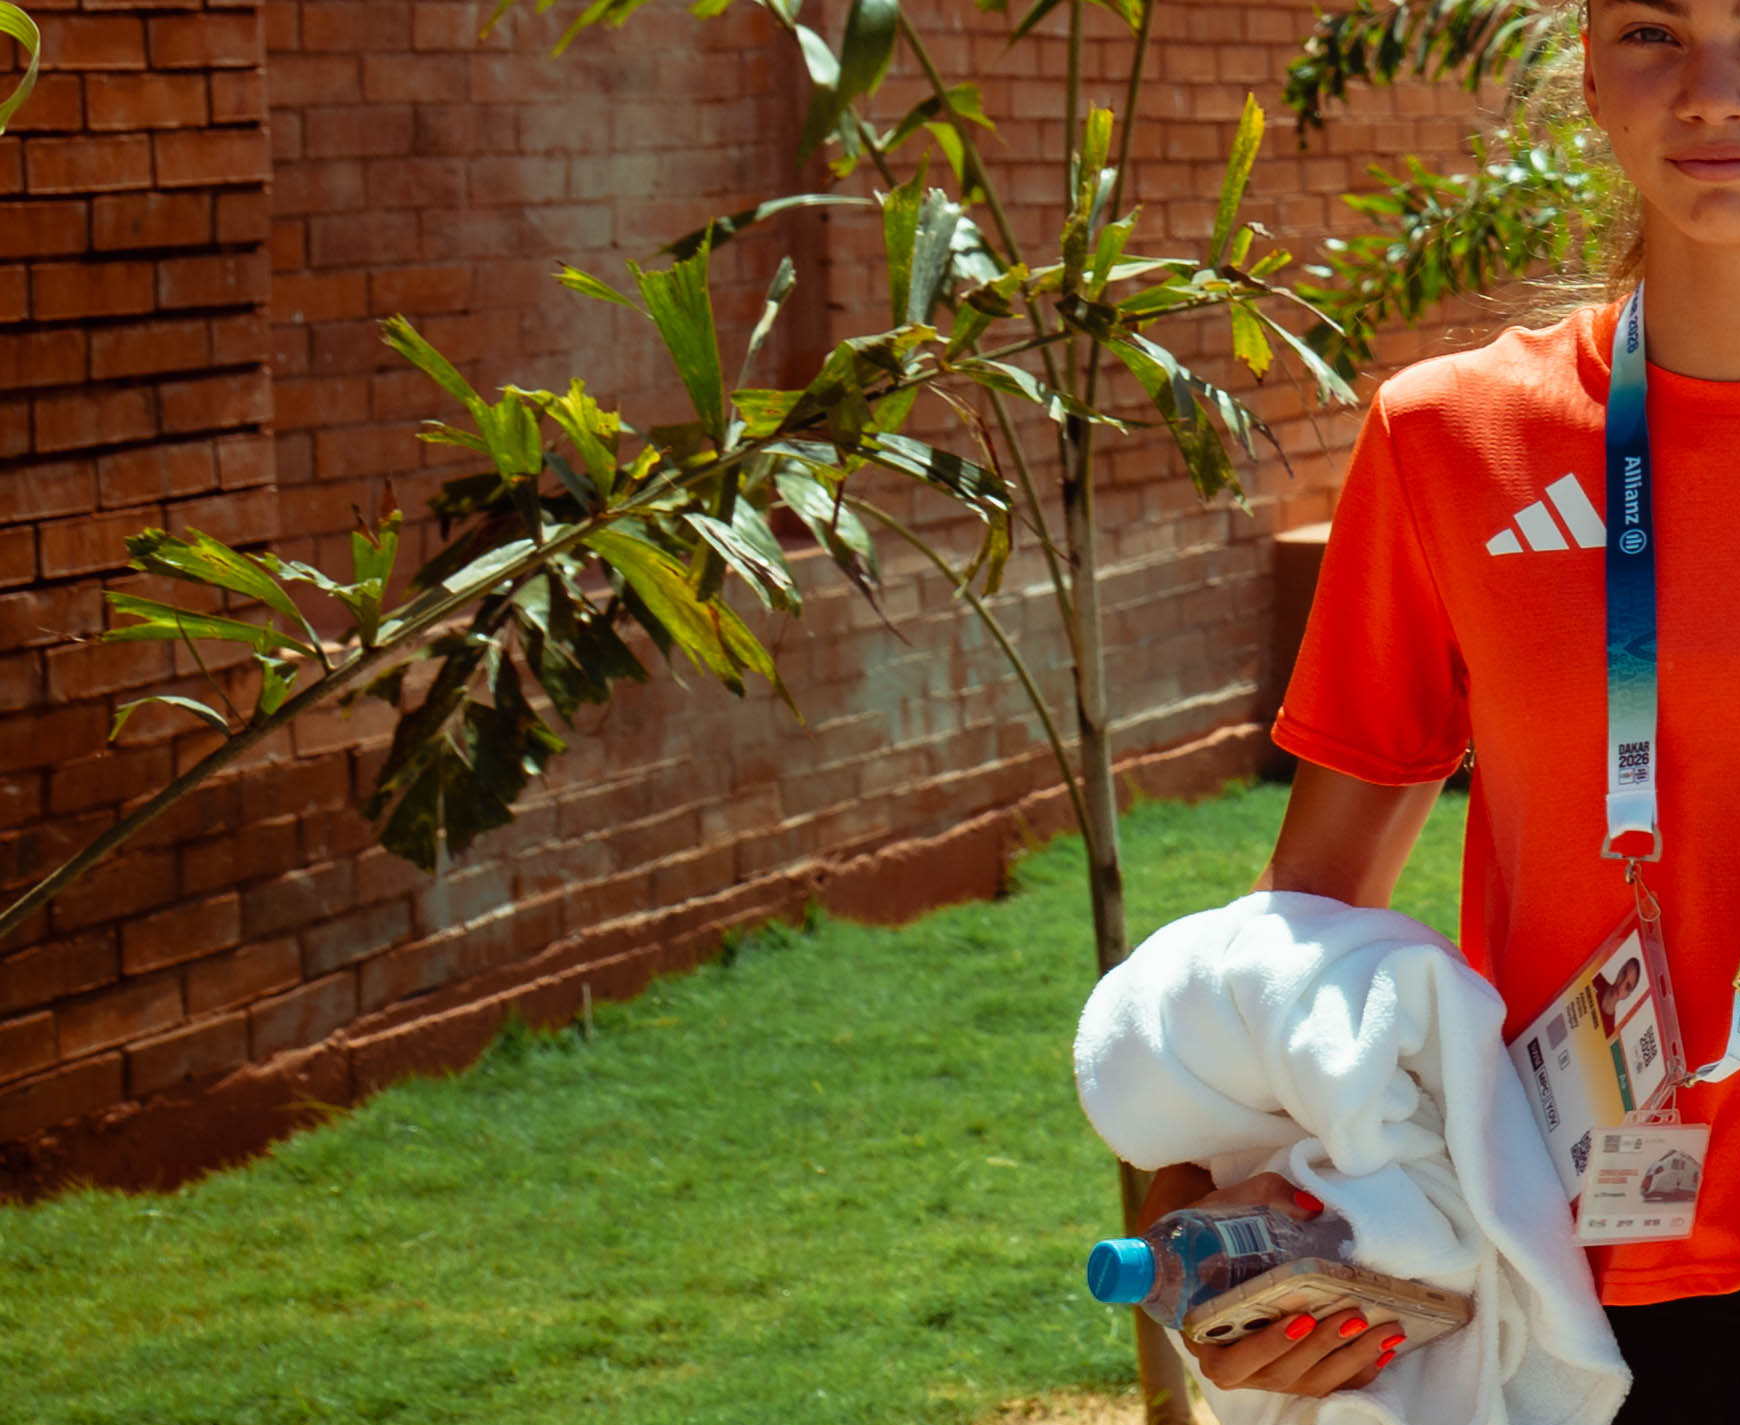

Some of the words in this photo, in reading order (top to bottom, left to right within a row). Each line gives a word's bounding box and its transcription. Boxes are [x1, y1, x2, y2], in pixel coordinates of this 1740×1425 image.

[1624, 456, 1642, 525] Allianz
[1618, 741, 1649, 755] DAKAR
[1618, 753, 1649, 768] 2026
